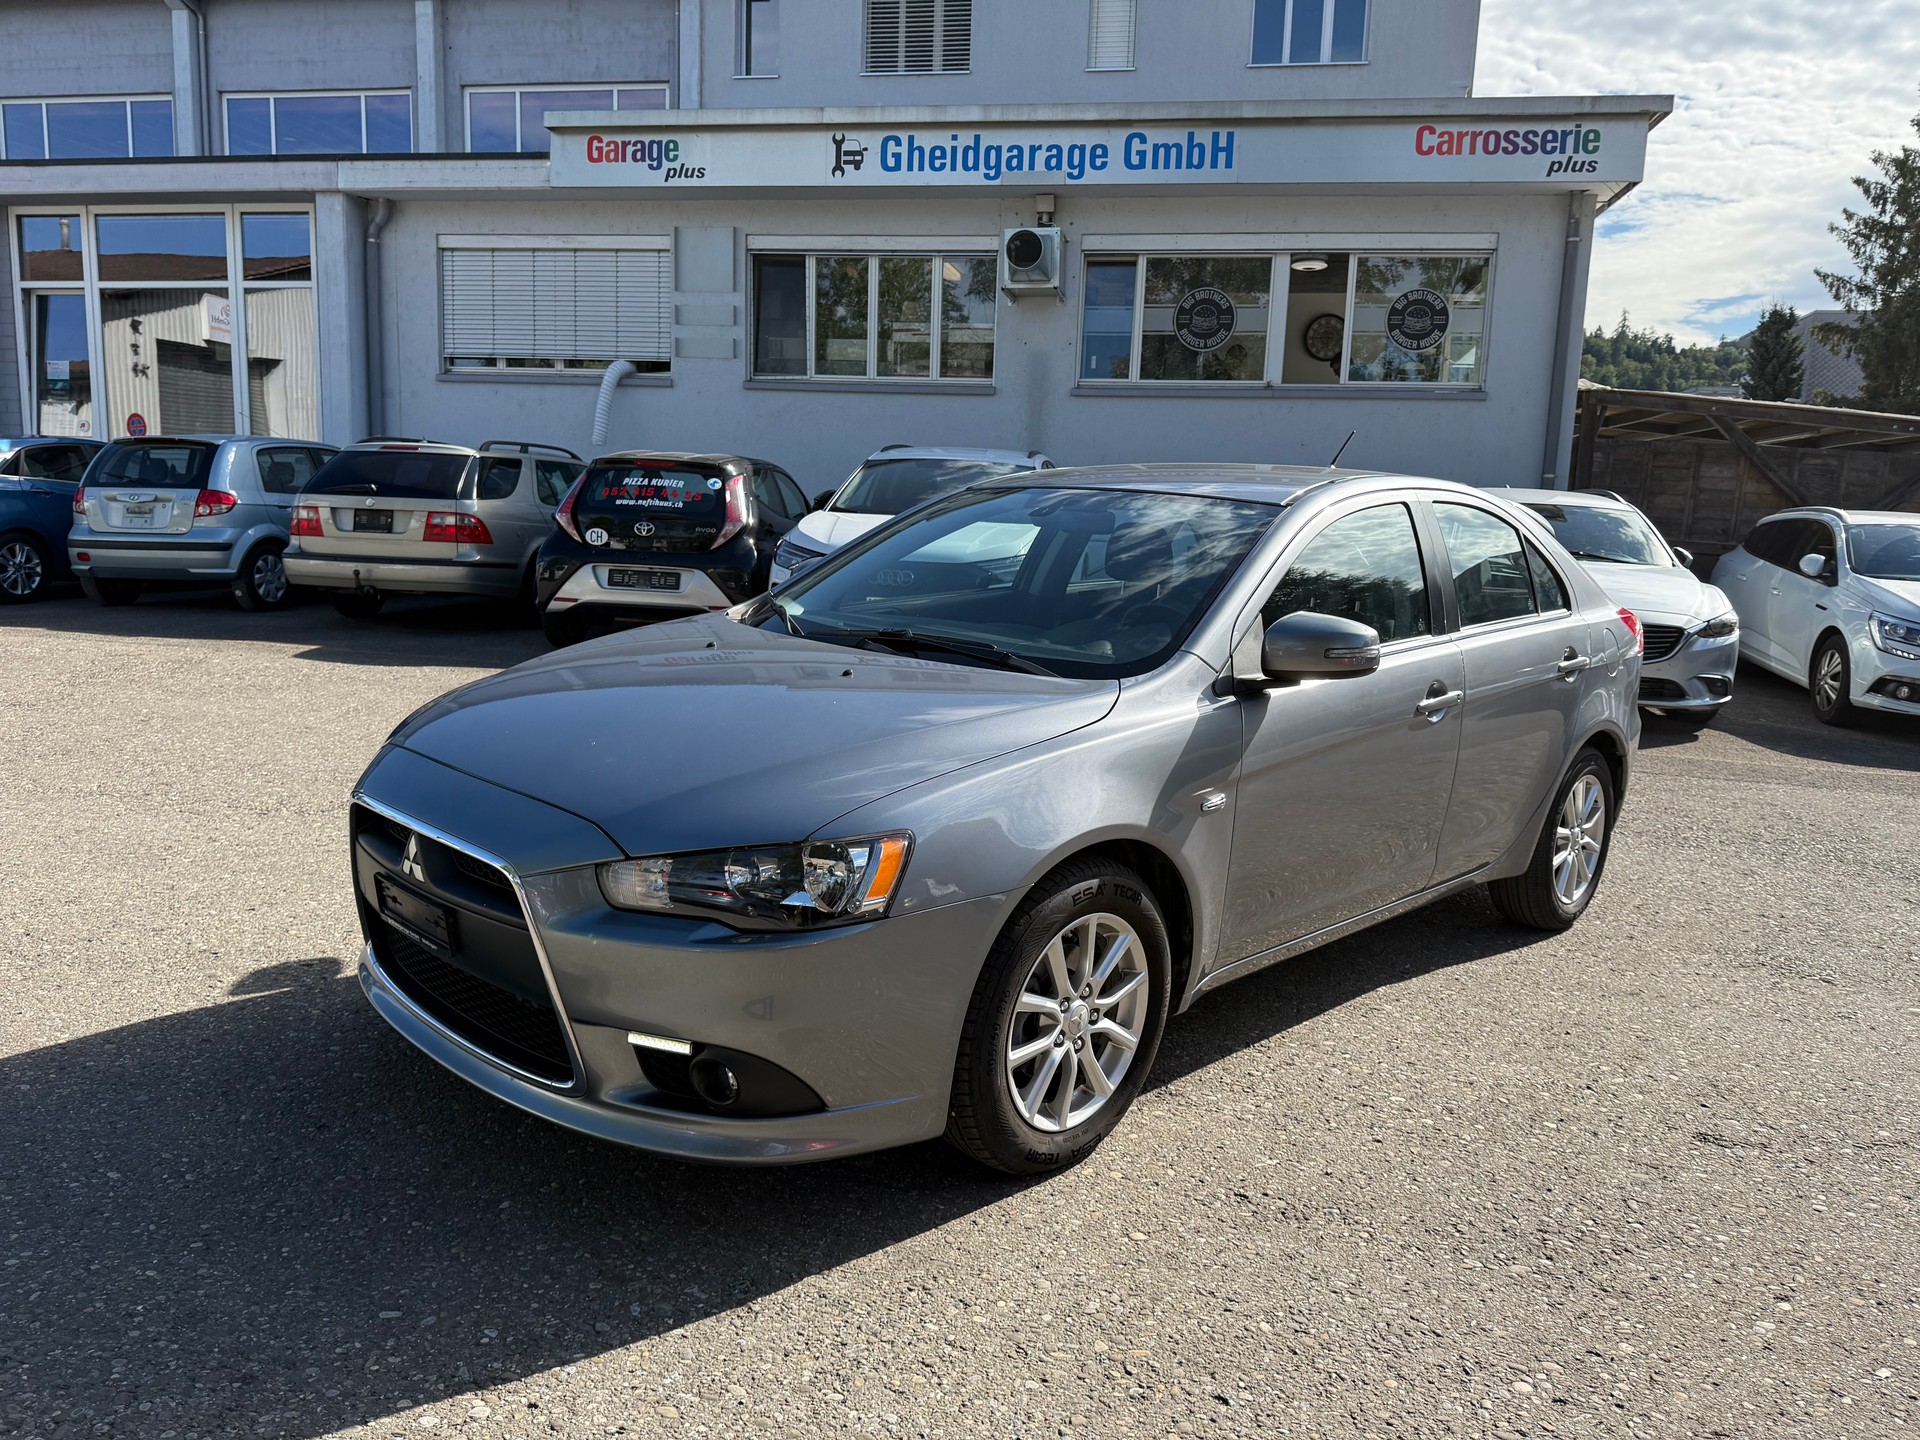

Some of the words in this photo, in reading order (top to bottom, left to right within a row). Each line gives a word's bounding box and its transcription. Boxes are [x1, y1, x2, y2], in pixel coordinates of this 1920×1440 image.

[1415, 123, 1601, 156] Carrosserie
[587, 134, 680, 171] Garage
[879, 134, 1109, 181] Gheidgarage
[1123, 131, 1235, 171] GmbH
[664, 163, 707, 182] plus
[1545, 156, 1599, 177] plus
[1182, 296, 1195, 309] BIG
[1194, 290, 1230, 309] BROTHERS
[1394, 296, 1408, 310] BIG
[1407, 290, 1445, 310] BROTHERS
[1180, 328, 1205, 348] BURGER
[1206, 328, 1229, 347] HOUSE
[1391, 329, 1418, 349] BURGER
[1419, 329, 1443, 348] HOUSE
[622, 477, 649, 486] PIZZA
[650, 478, 685, 488] KURIER
[602, 487, 628, 496] 052
[632, 487, 655, 497] 315
[660, 489, 679, 499] 44
[684, 491, 703, 501] 55
[615, 498, 684, 508] www.neftihuus.ch
[590, 530, 603, 544] CH
[1113, 883, 1143, 907] TECAR
[1024, 1147, 1061, 1166] TECAR
